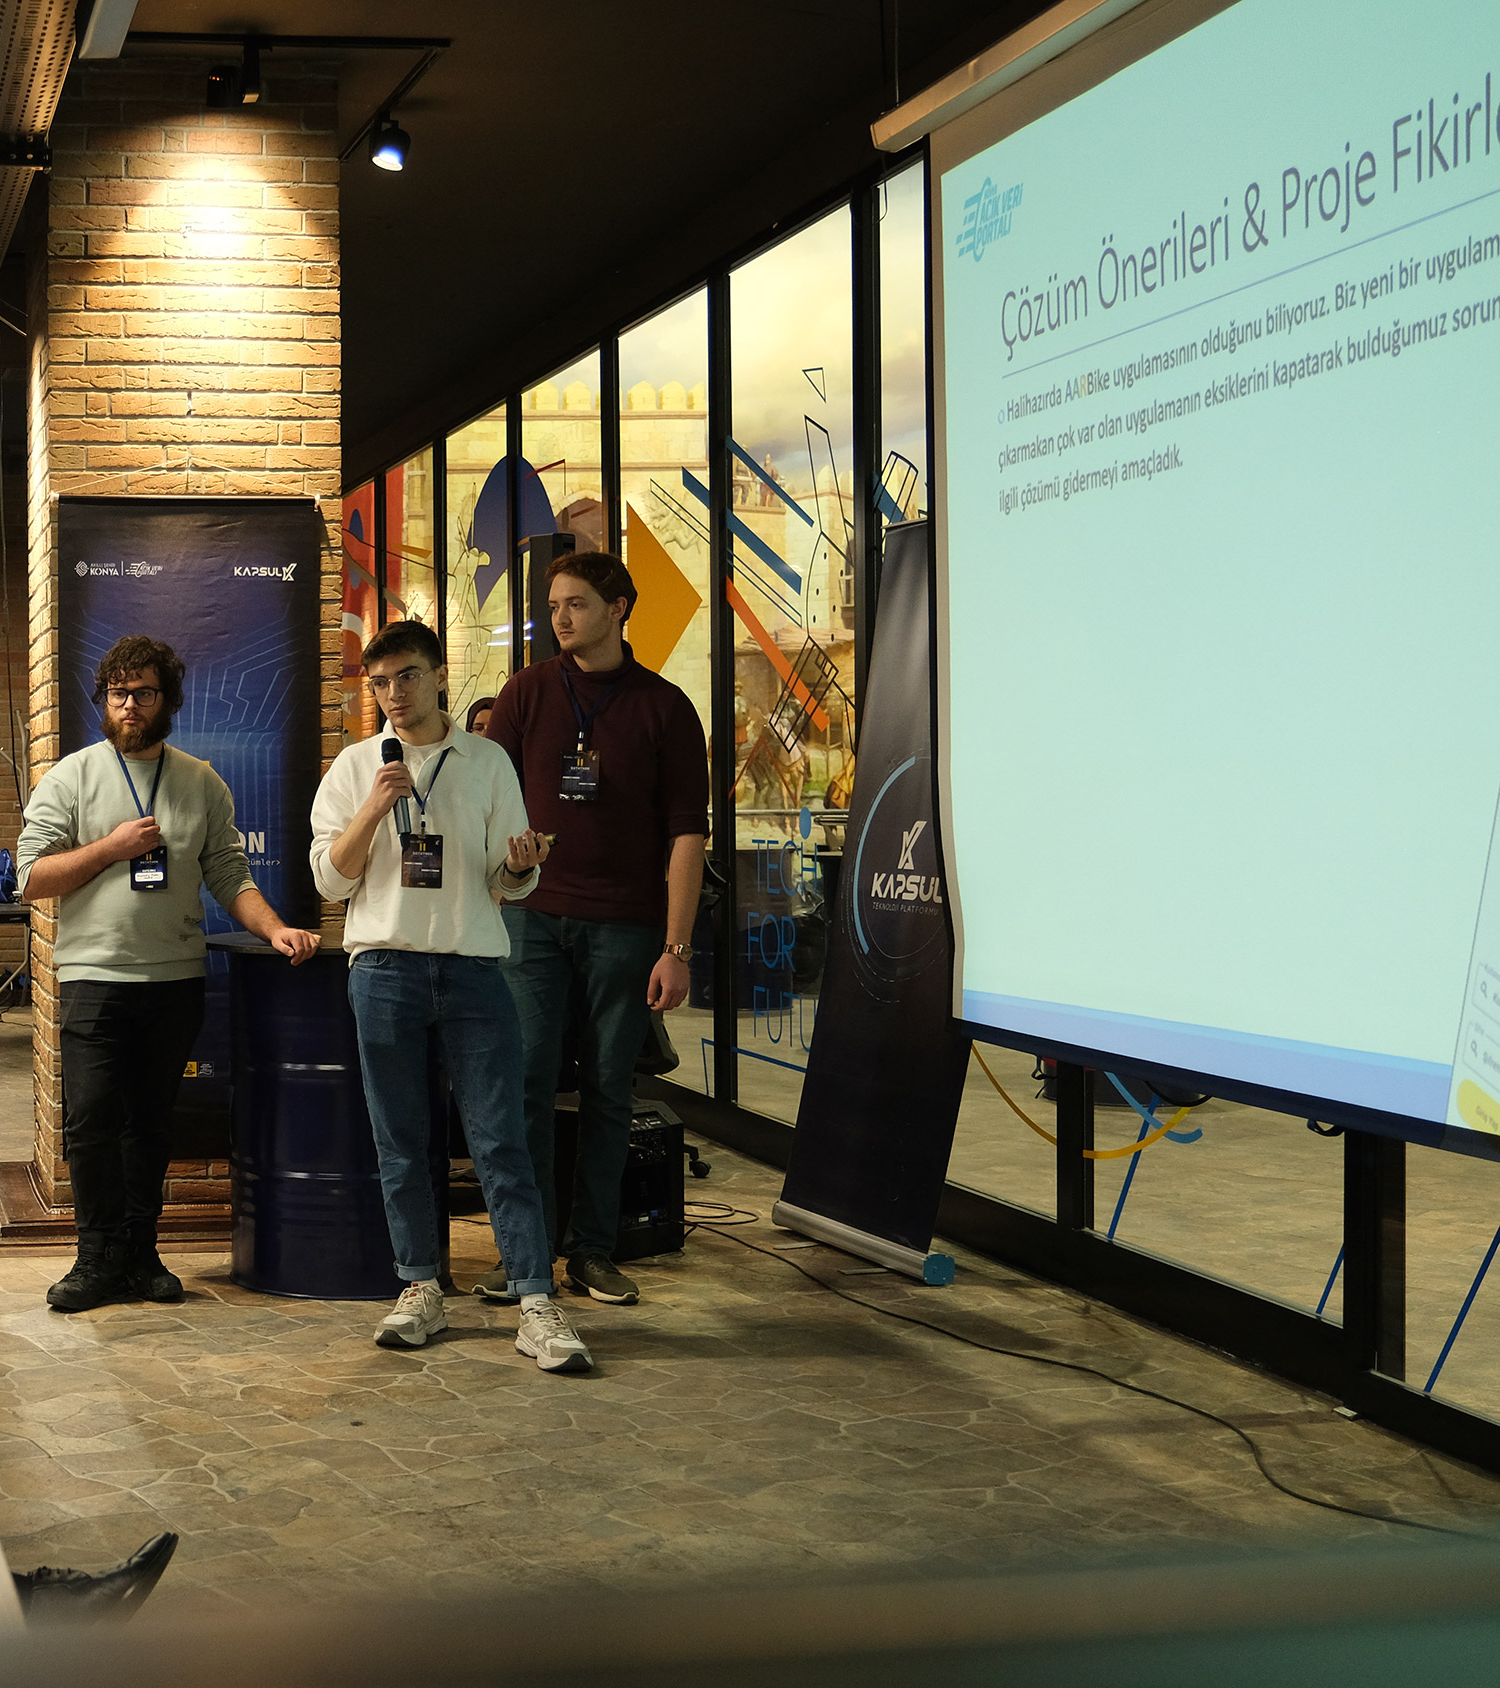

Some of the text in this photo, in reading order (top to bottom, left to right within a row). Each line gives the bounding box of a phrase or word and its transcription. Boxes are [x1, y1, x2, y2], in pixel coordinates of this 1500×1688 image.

[1001, 72, 1500, 362] Çözüm Önerileri & Proje Fikirl
[1006, 234, 1500, 423] Halihazırda AARBike uygulamasının olduğunu biliyoruz. Biz yeni bir uygulam
[998, 435, 1054, 474] çıkarmakan
[1057, 424, 1076, 456] çok
[1077, 423, 1095, 446] var
[1097, 414, 1122, 440] olan
[1125, 391, 1201, 436] uygulamanın
[1204, 363, 1269, 408] eksiklerini
[1273, 340, 1343, 389] kapatarak
[1347, 312, 1447, 364] bulduğumuz
[999, 443, 1183, 516] ilgili çözümü gidermeyi amaçladık.
[90, 568, 119, 576] KONYA
[752, 839, 818, 897] TECH
[871, 872, 943, 904] KAPSUL
[747, 912, 796, 972] FOR
